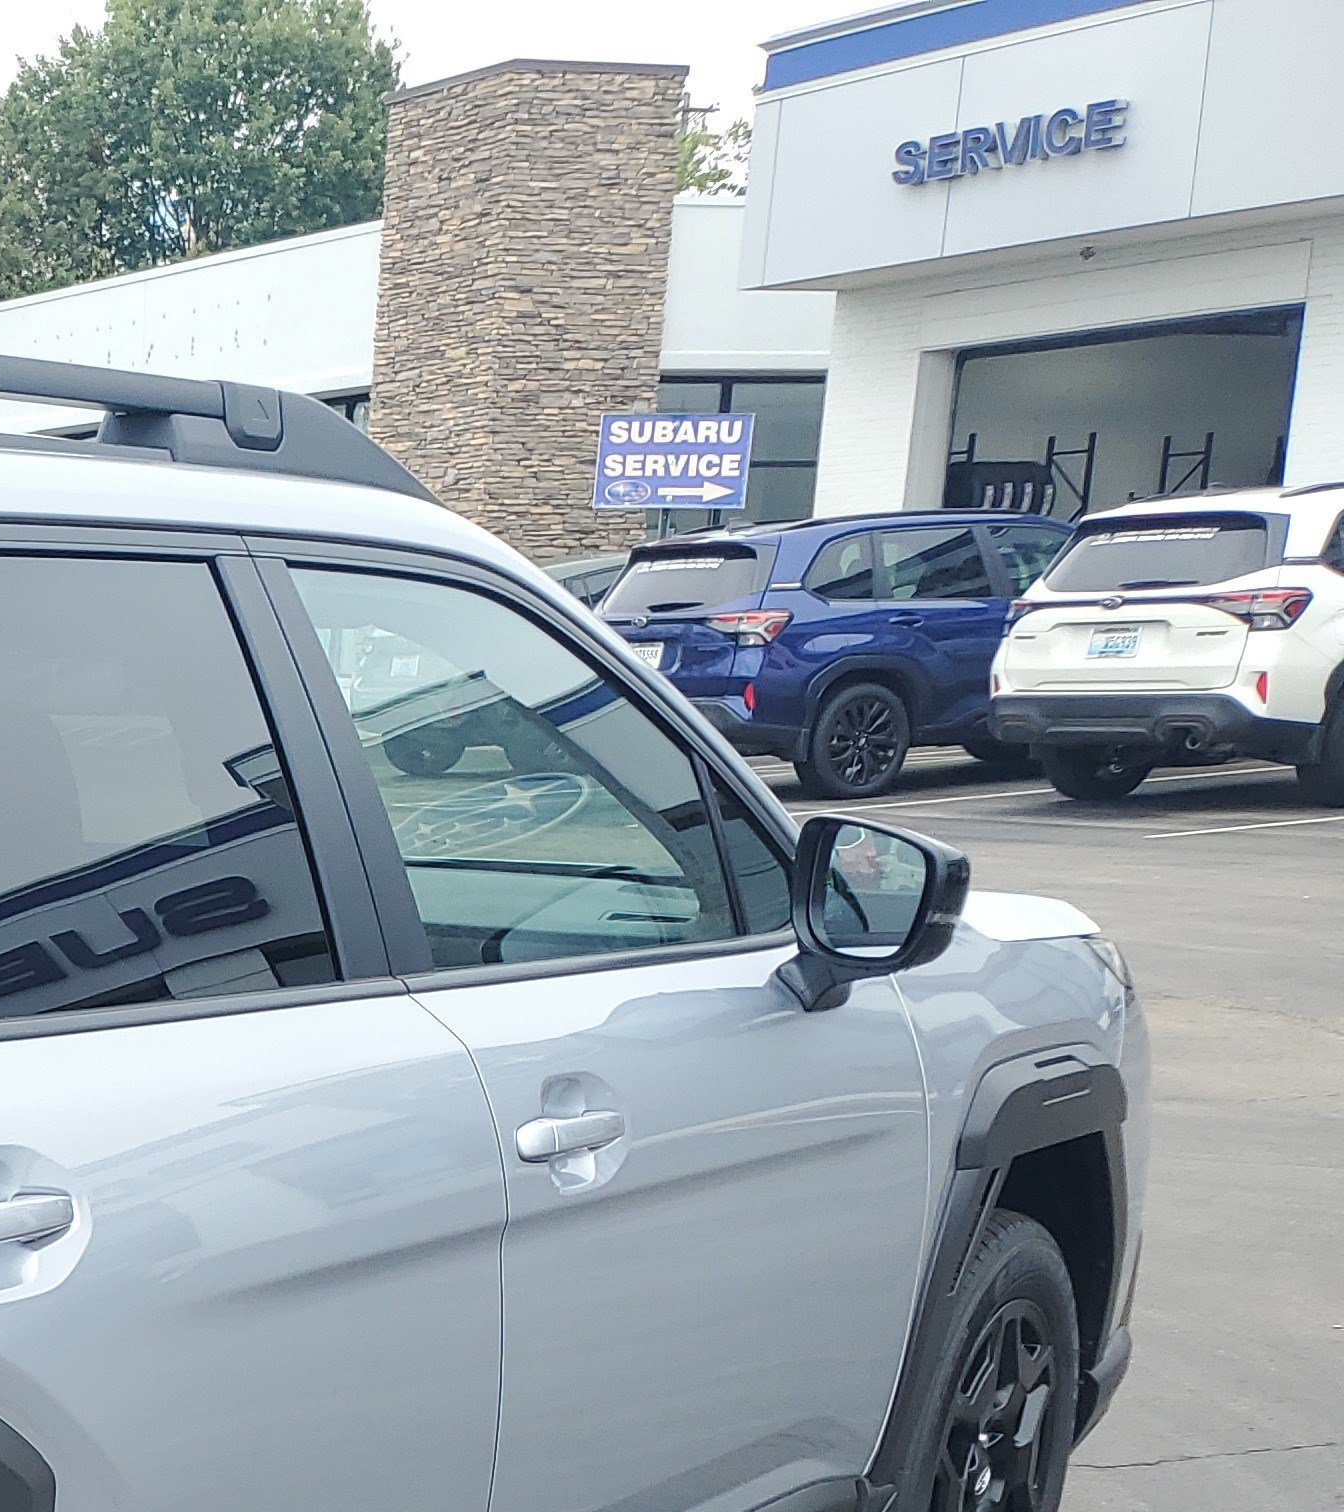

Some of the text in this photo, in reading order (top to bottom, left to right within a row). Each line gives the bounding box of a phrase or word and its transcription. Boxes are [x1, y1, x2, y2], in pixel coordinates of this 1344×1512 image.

[892, 100, 1128, 186] SERVICE
[609, 420, 743, 443] SUBARU
[603, 453, 741, 477] SERVICE
